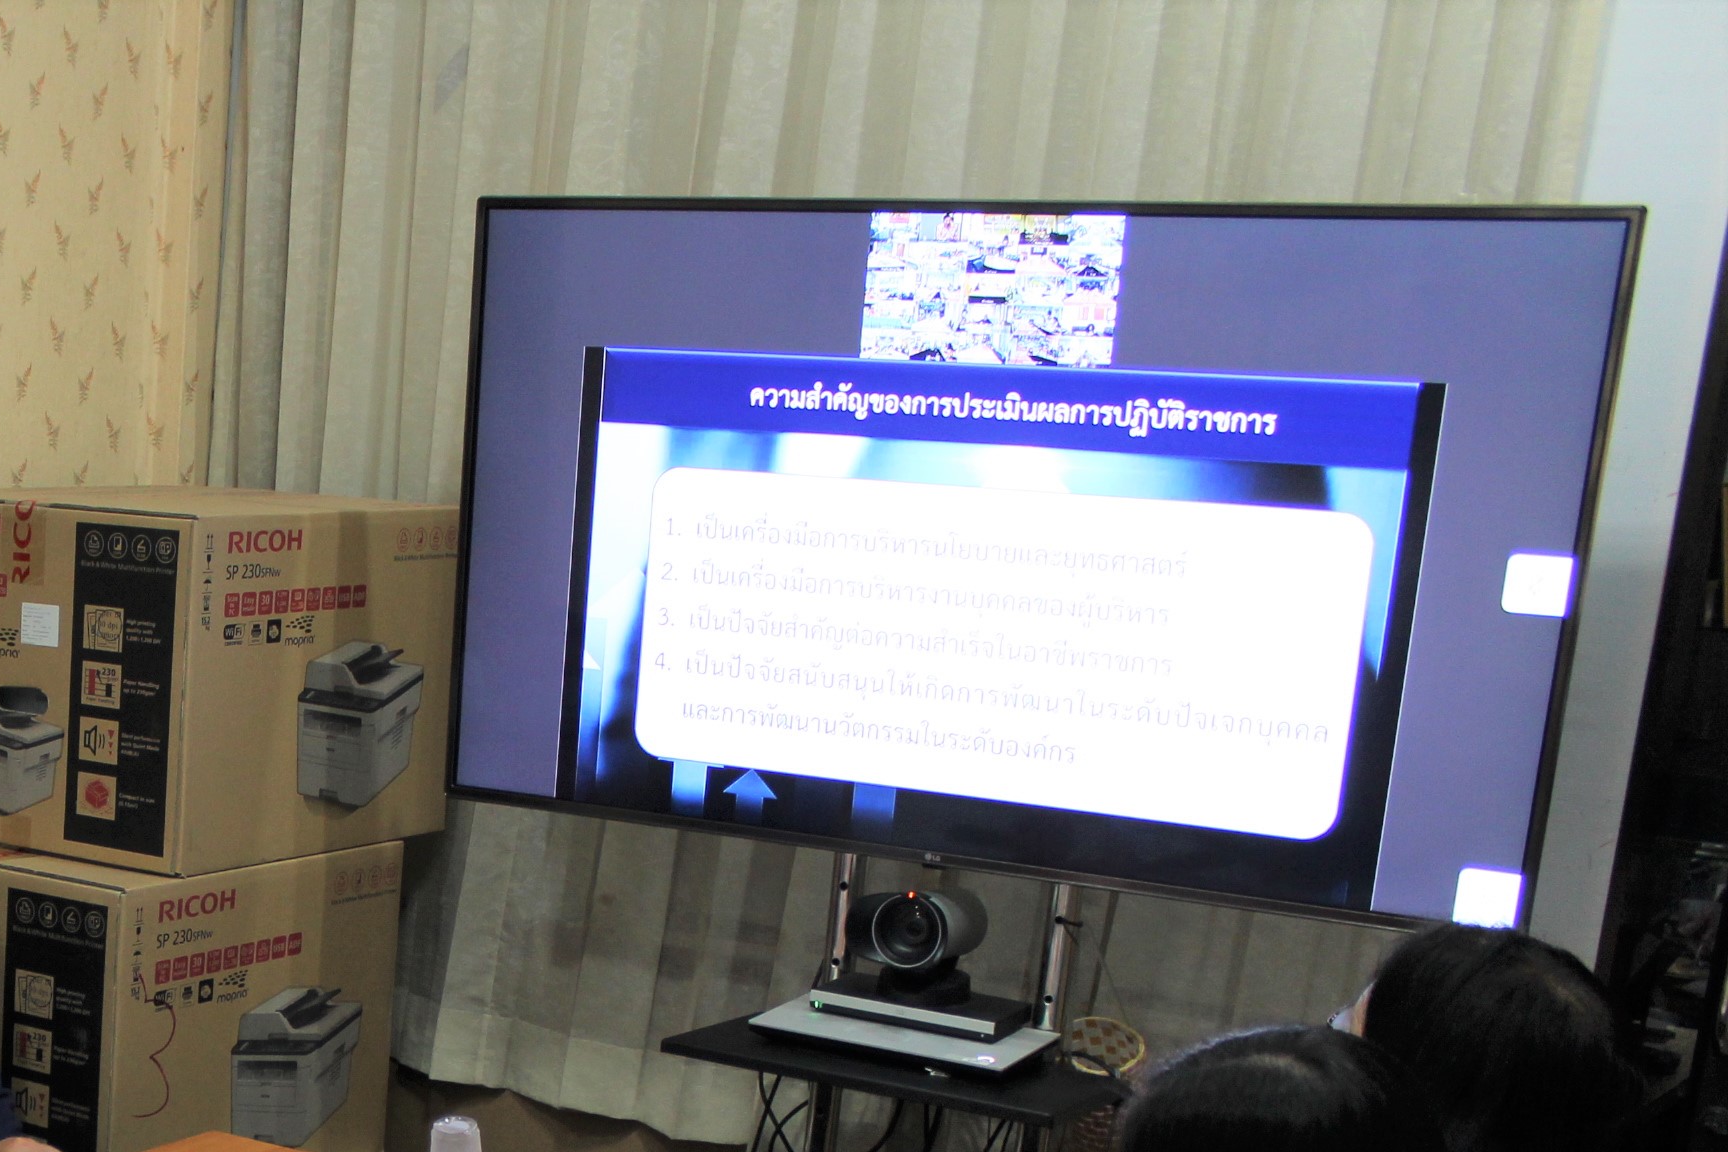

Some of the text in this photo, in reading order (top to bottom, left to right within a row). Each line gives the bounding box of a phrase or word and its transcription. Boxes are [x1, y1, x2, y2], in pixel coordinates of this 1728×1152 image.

[750, 382, 1277, 437] ความสำคัญของการประเมินผลการปฏิบัติราชการ
[227, 529, 303, 554] RICOH
[666, 512, 1189, 578] 1. เป็นเครื่องมือการบริหารนโยบายและยุทธศาสตร์
[226, 564, 239, 581] SP
[261, 596, 270, 606] 30
[660, 559, 1170, 628] 2. เป็นเครื่องมือการบริหารงานบุคคลของผู้บริหาร
[284, 636, 314, 648] mopria
[657, 606, 1173, 676] 3. เป็นปัจจัยสำคัญต่อความสำเร็จในอาชีพราชการ
[102, 668, 116, 677] 230
[653, 650, 1329, 746] 4. เป็นปัจจัยสนับสนุนให้เกิดการพัฒนาในระดับปัจเจกบุคคล
[682, 700, 1076, 765] และการพัฒนานวัตกรรมในระดับองค์กร
[158, 888, 236, 924] RICOH
[156, 935, 170, 949] SP
[192, 957, 202, 968] 30
[217, 988, 248, 1005] mopria
